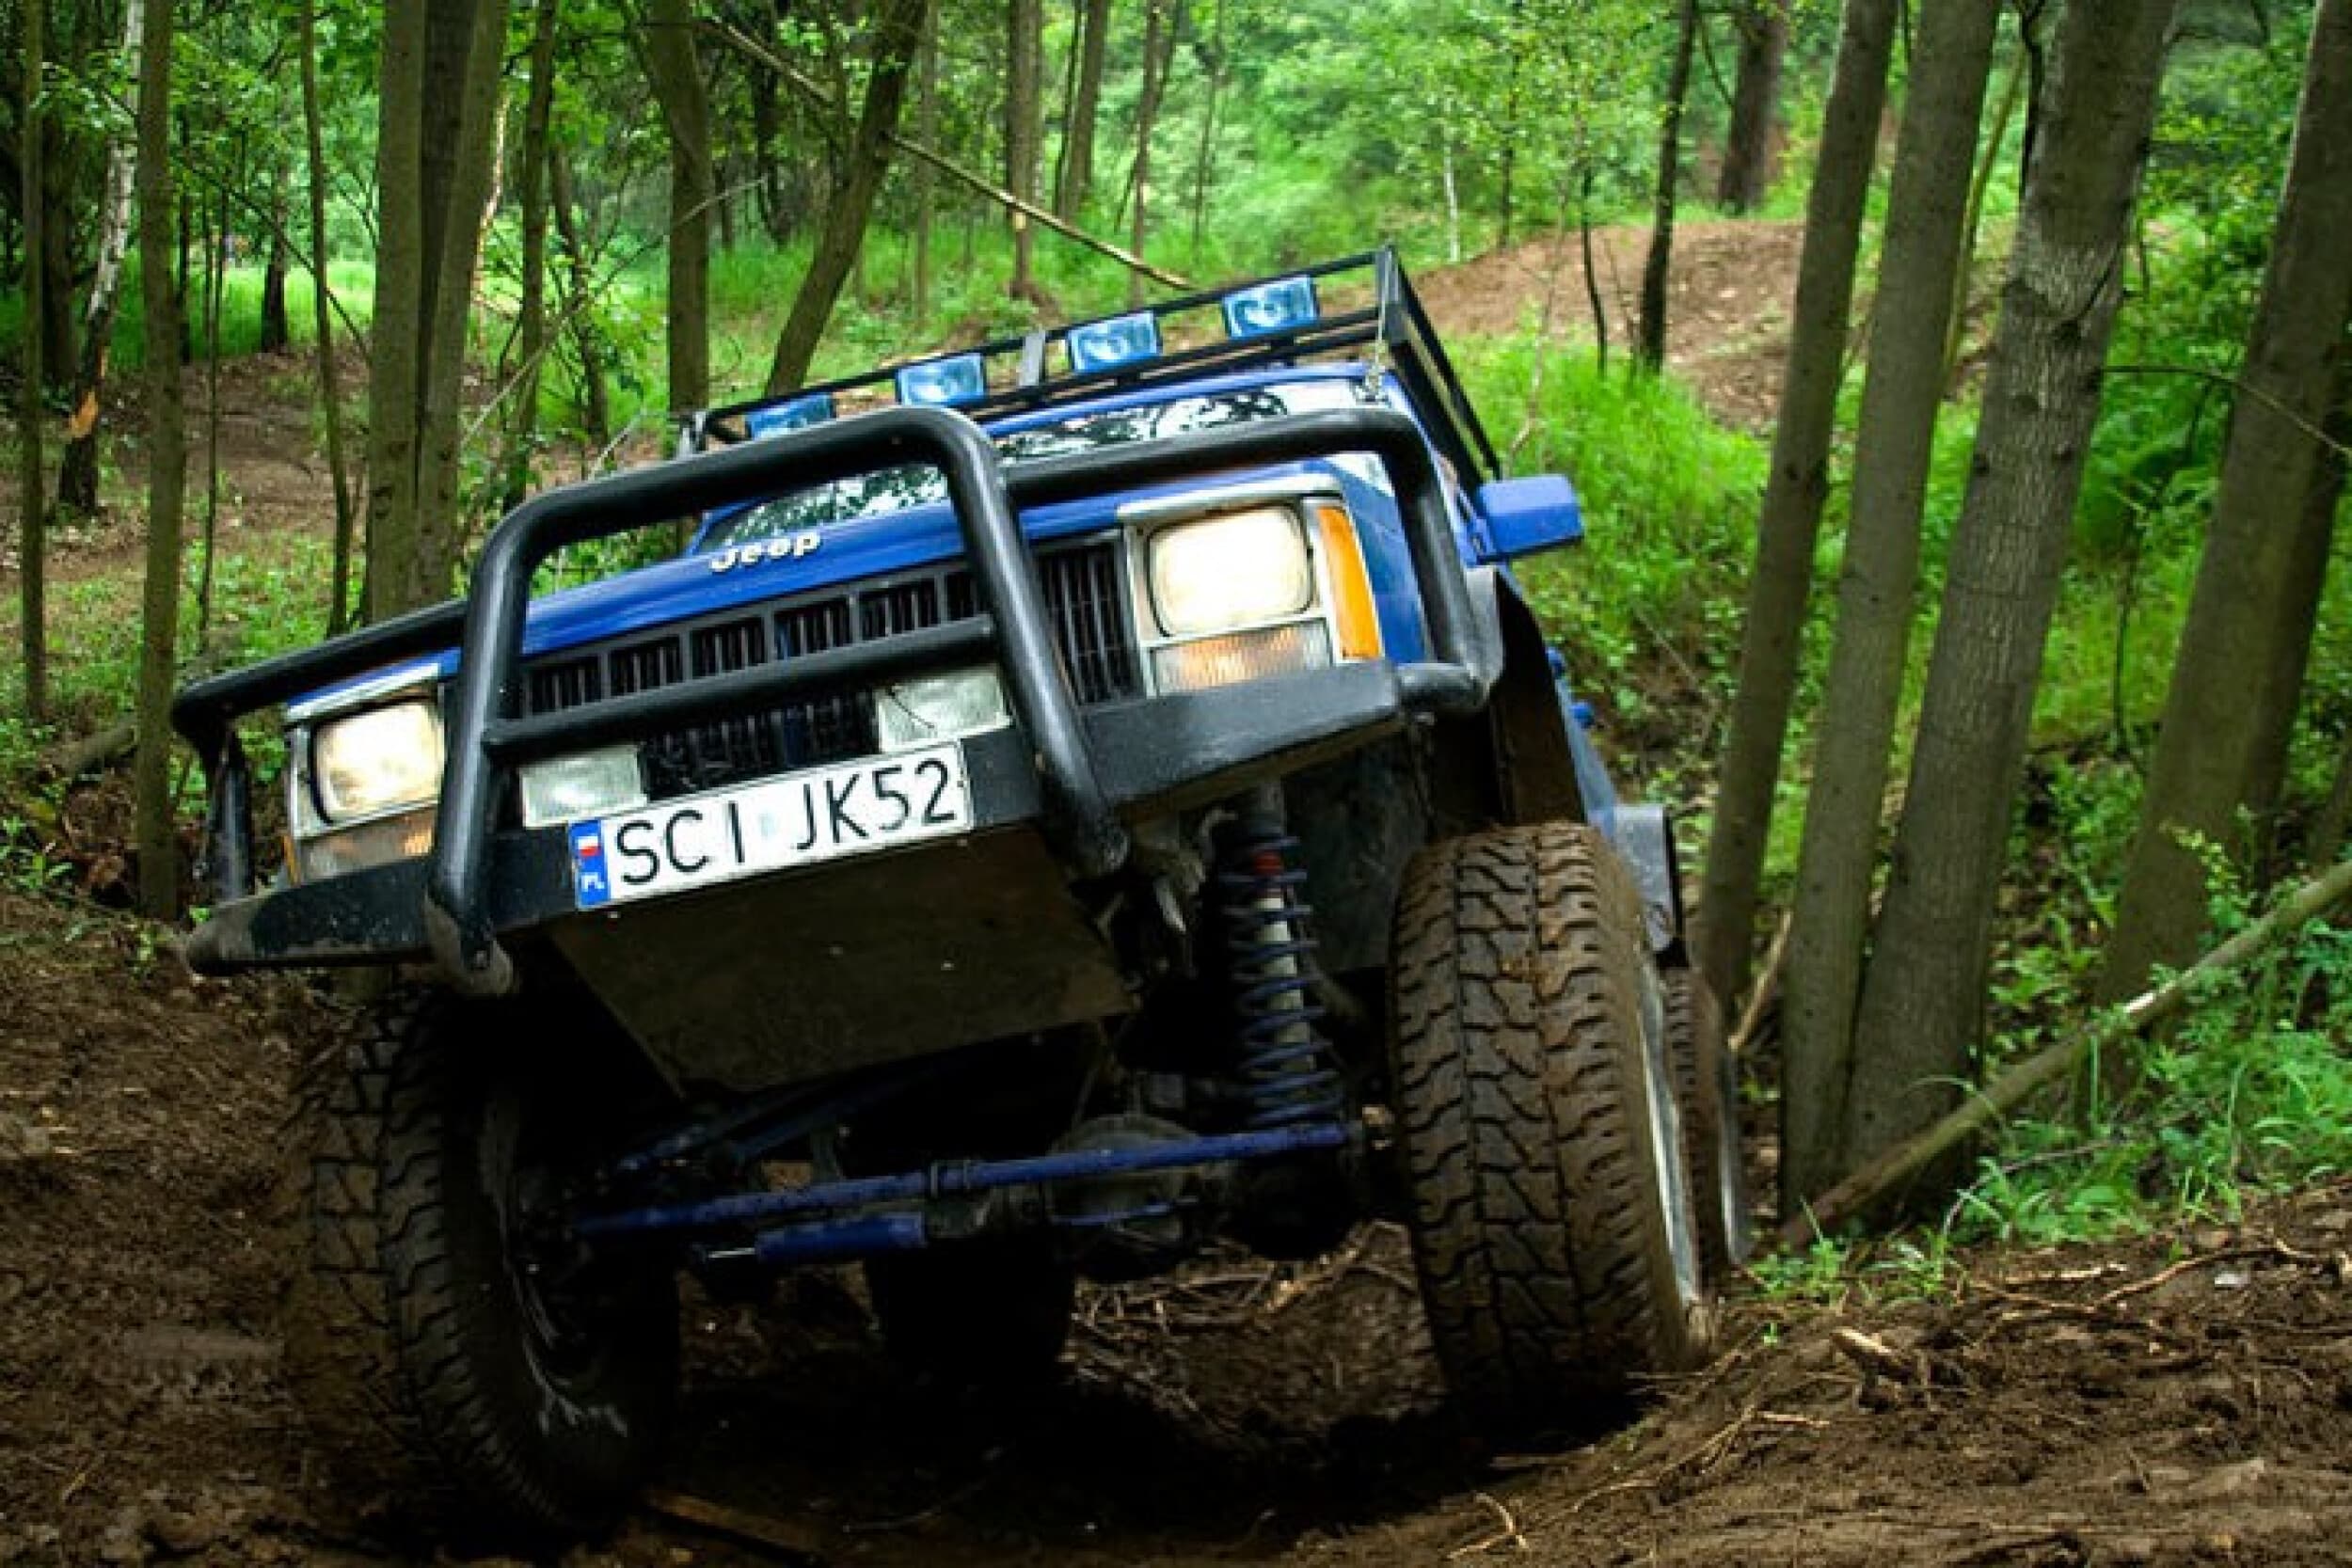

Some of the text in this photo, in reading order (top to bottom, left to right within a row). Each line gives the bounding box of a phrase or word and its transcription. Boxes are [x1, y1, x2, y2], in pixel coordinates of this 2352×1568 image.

[710, 531, 820, 570] Jeep
[616, 758, 958, 885] SCI JK52
